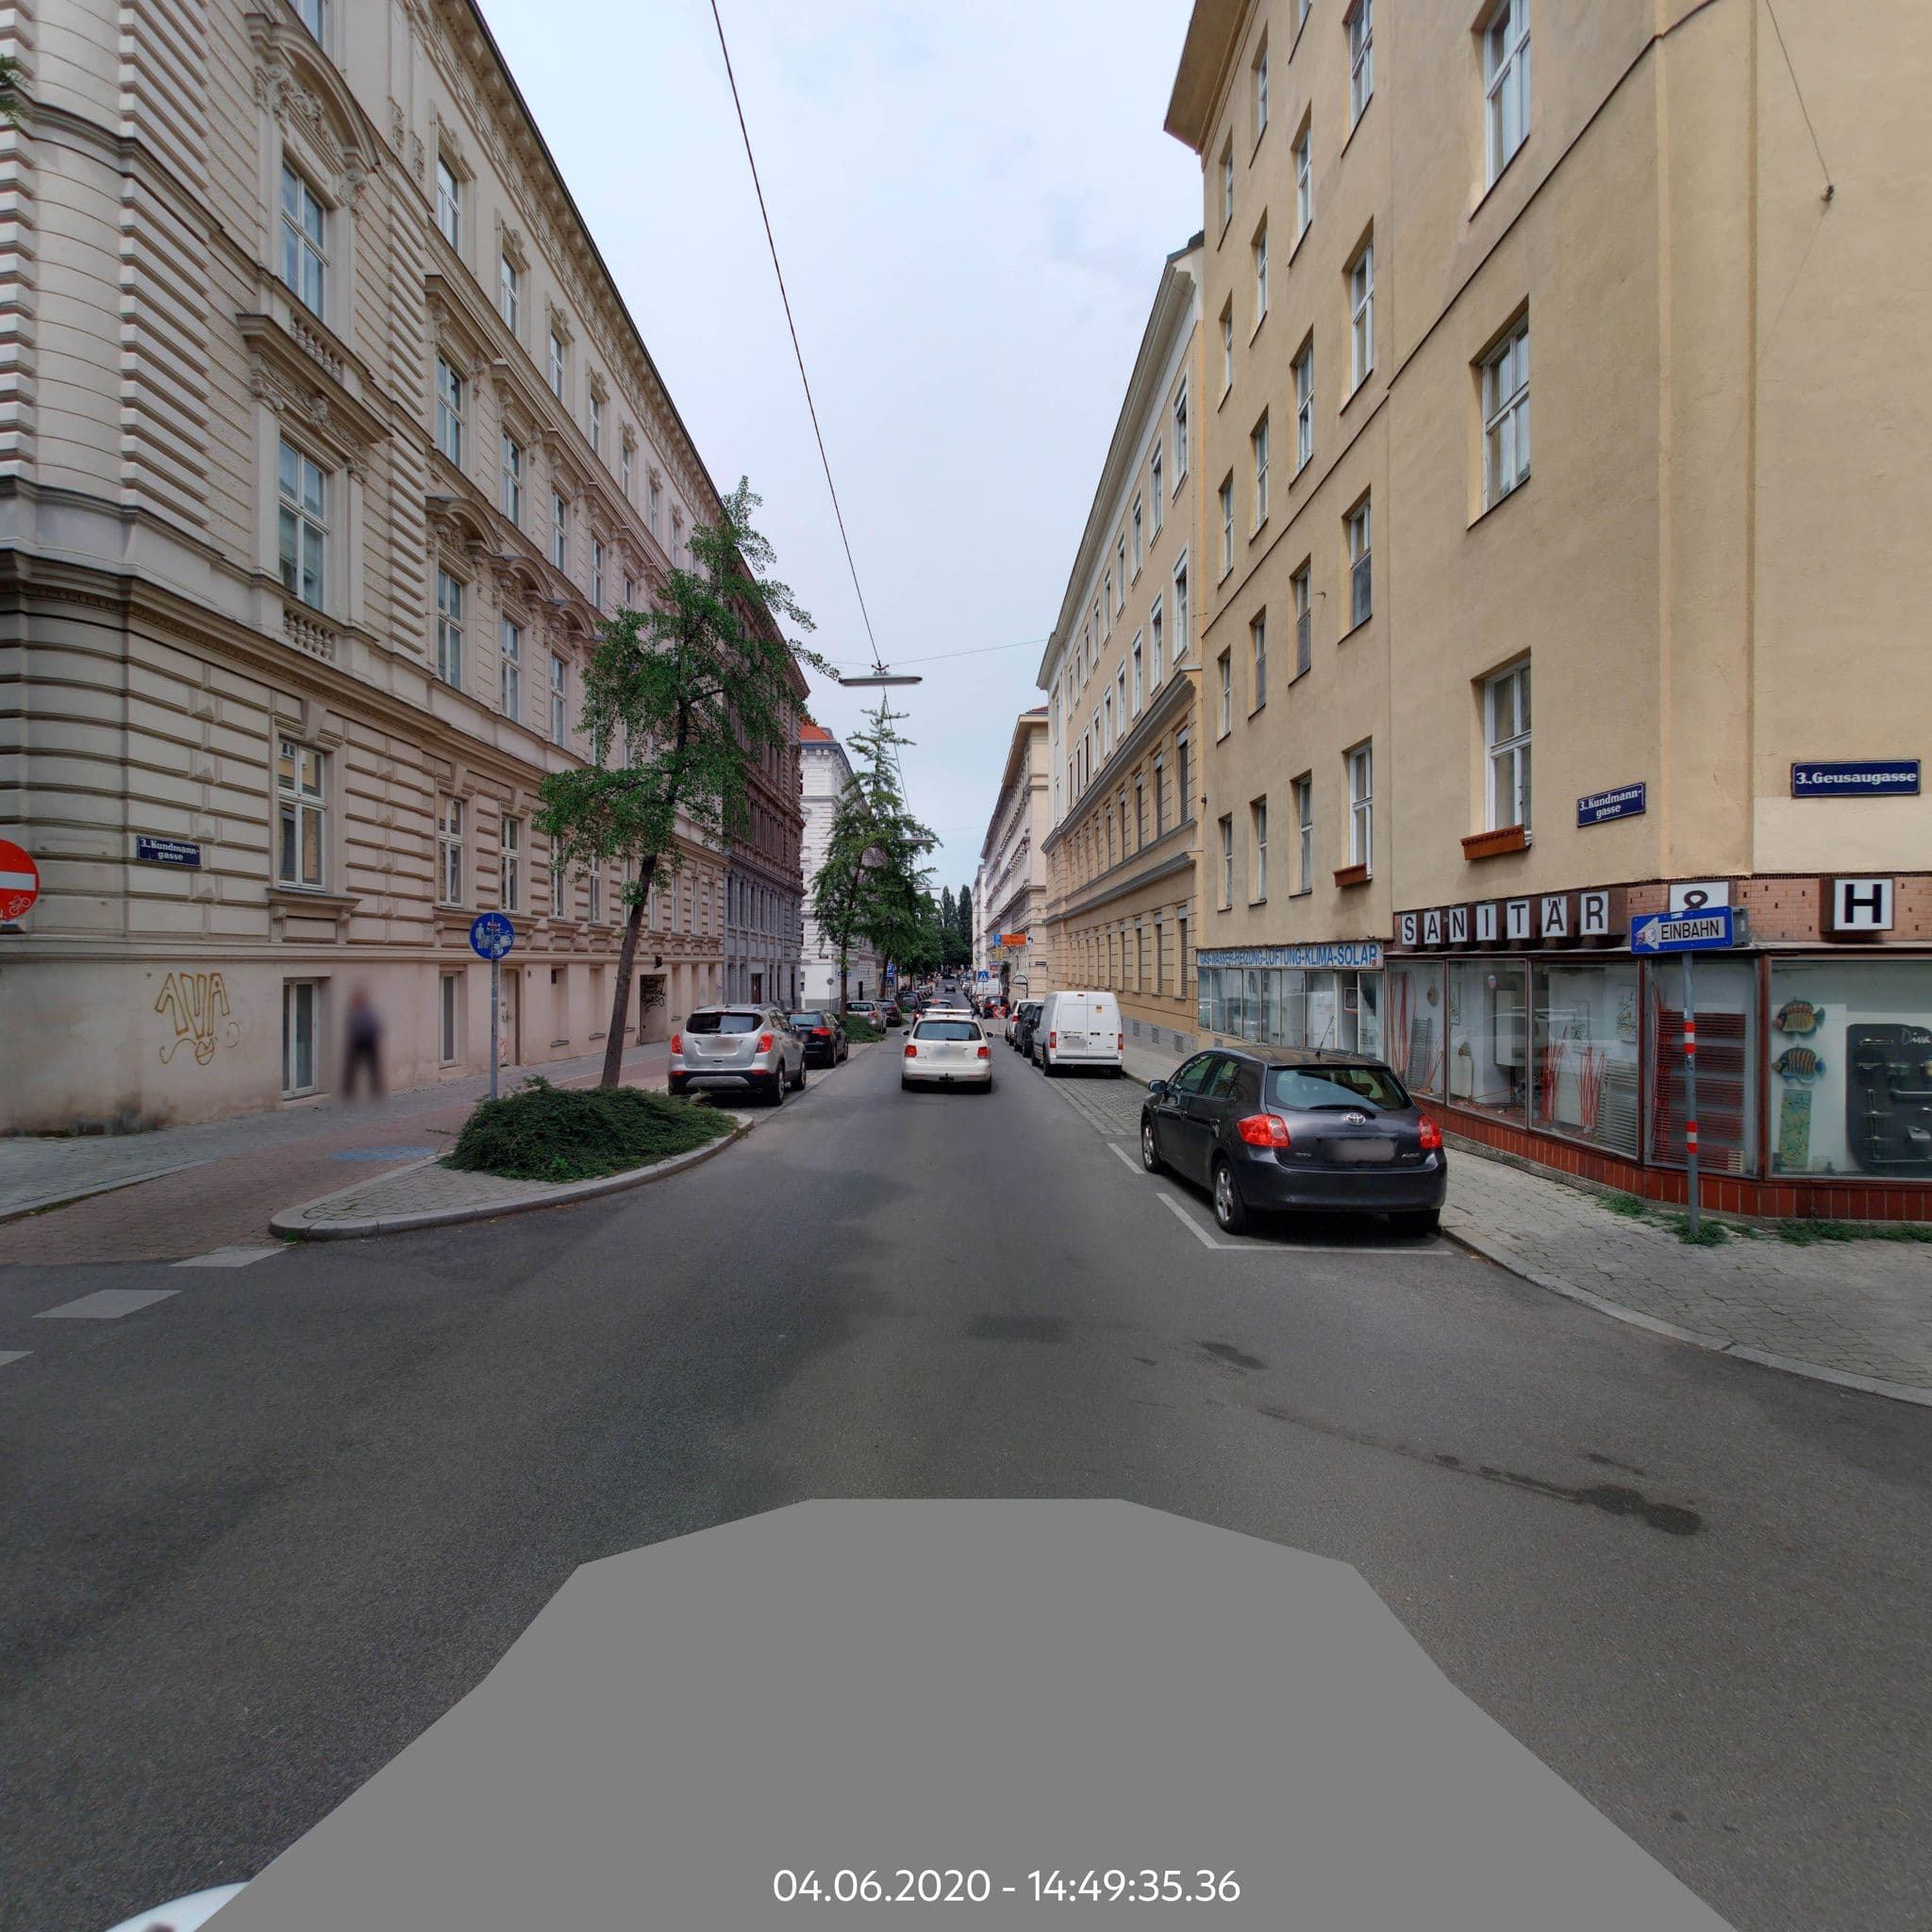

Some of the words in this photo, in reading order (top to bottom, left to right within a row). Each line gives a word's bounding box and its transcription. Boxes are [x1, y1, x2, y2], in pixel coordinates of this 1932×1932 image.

[1811, 772, 1917, 785] Geusaugasse
[1596, 805, 1621, 820] gasse
[158, 852, 184, 860] gasse
[1405, 895, 1604, 941] SANITÄR
[1661, 919, 1720, 940] EINBAHN
